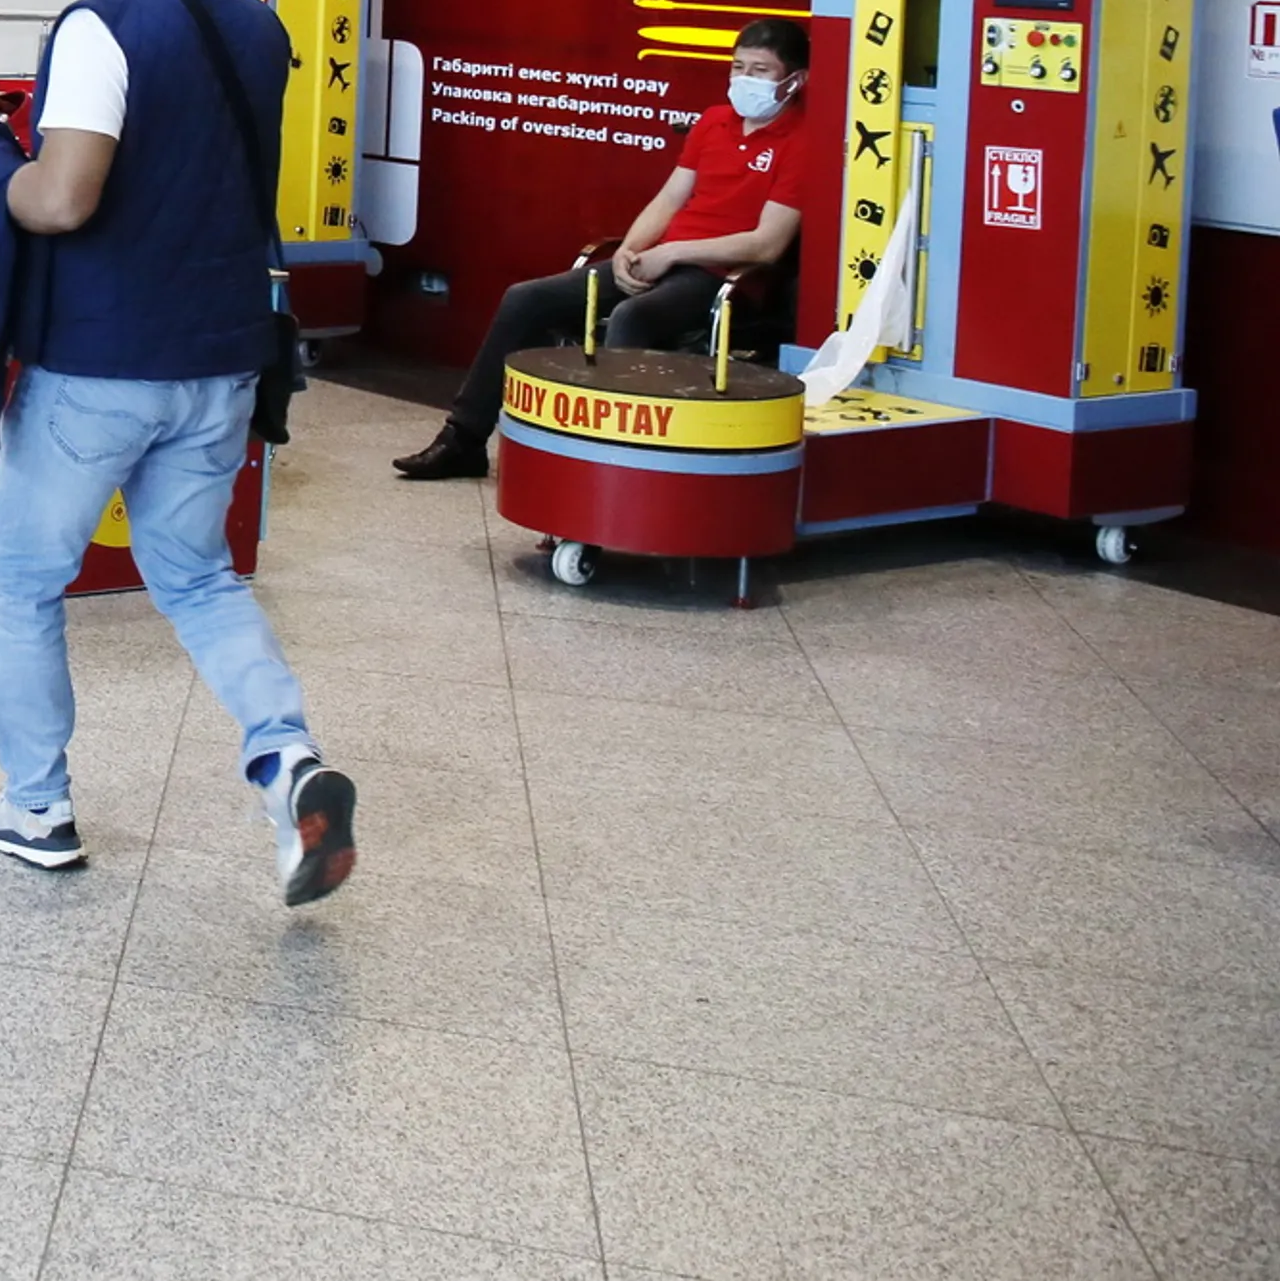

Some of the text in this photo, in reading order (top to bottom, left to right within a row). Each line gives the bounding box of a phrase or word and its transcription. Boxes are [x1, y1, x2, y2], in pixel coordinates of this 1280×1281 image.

[432, 56, 514, 79] Габаритті
[517, 66, 562, 84] емес
[622, 76, 670, 96] орау
[431, 81, 703, 127] Упаковка негабаритного груз
[431, 108, 666, 151] Packing of oversized cargo
[989, 150, 1040, 165] СТЕКЛО
[987, 211, 1038, 228] FRAGILE
[553, 391, 675, 438] QAPTAY
